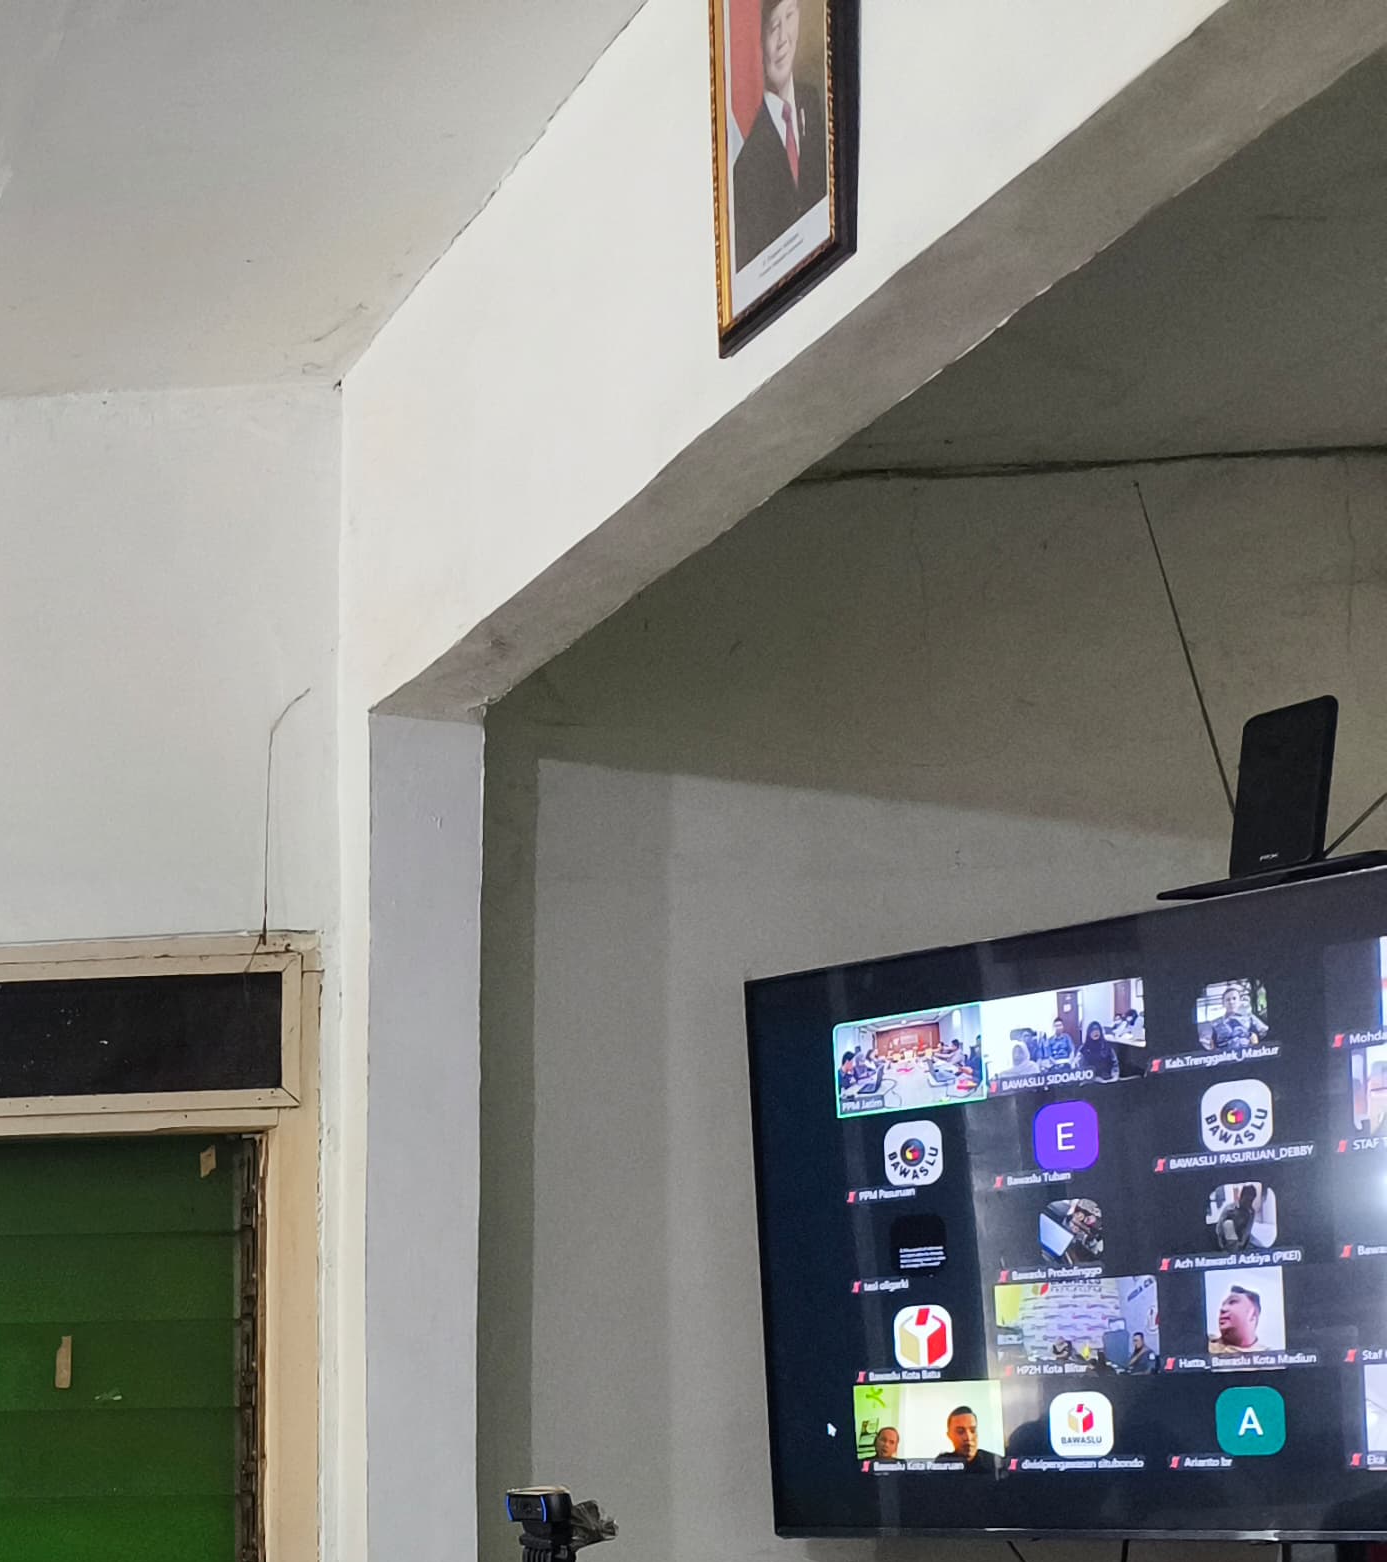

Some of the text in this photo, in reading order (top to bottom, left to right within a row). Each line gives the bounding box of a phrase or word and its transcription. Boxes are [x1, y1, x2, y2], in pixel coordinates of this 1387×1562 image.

[1002, 1069, 1094, 1092] BAWASLU SIDOARJO
[1056, 1122, 1076, 1151] E
[1205, 1107, 1269, 1147] BAWASLU
[888, 1146, 939, 1180] BAWASLU
[1169, 1156, 1216, 1170] BAWASLU
[1042, 1364, 1062, 1374] Kota
[1211, 1356, 1251, 1367] Bawaslu
[1253, 1354, 1275, 1366] Kota
[1278, 1352, 1317, 1364] Madiun
[1238, 1406, 1264, 1436] A
[1061, 1435, 1102, 1445] BAWASLU
